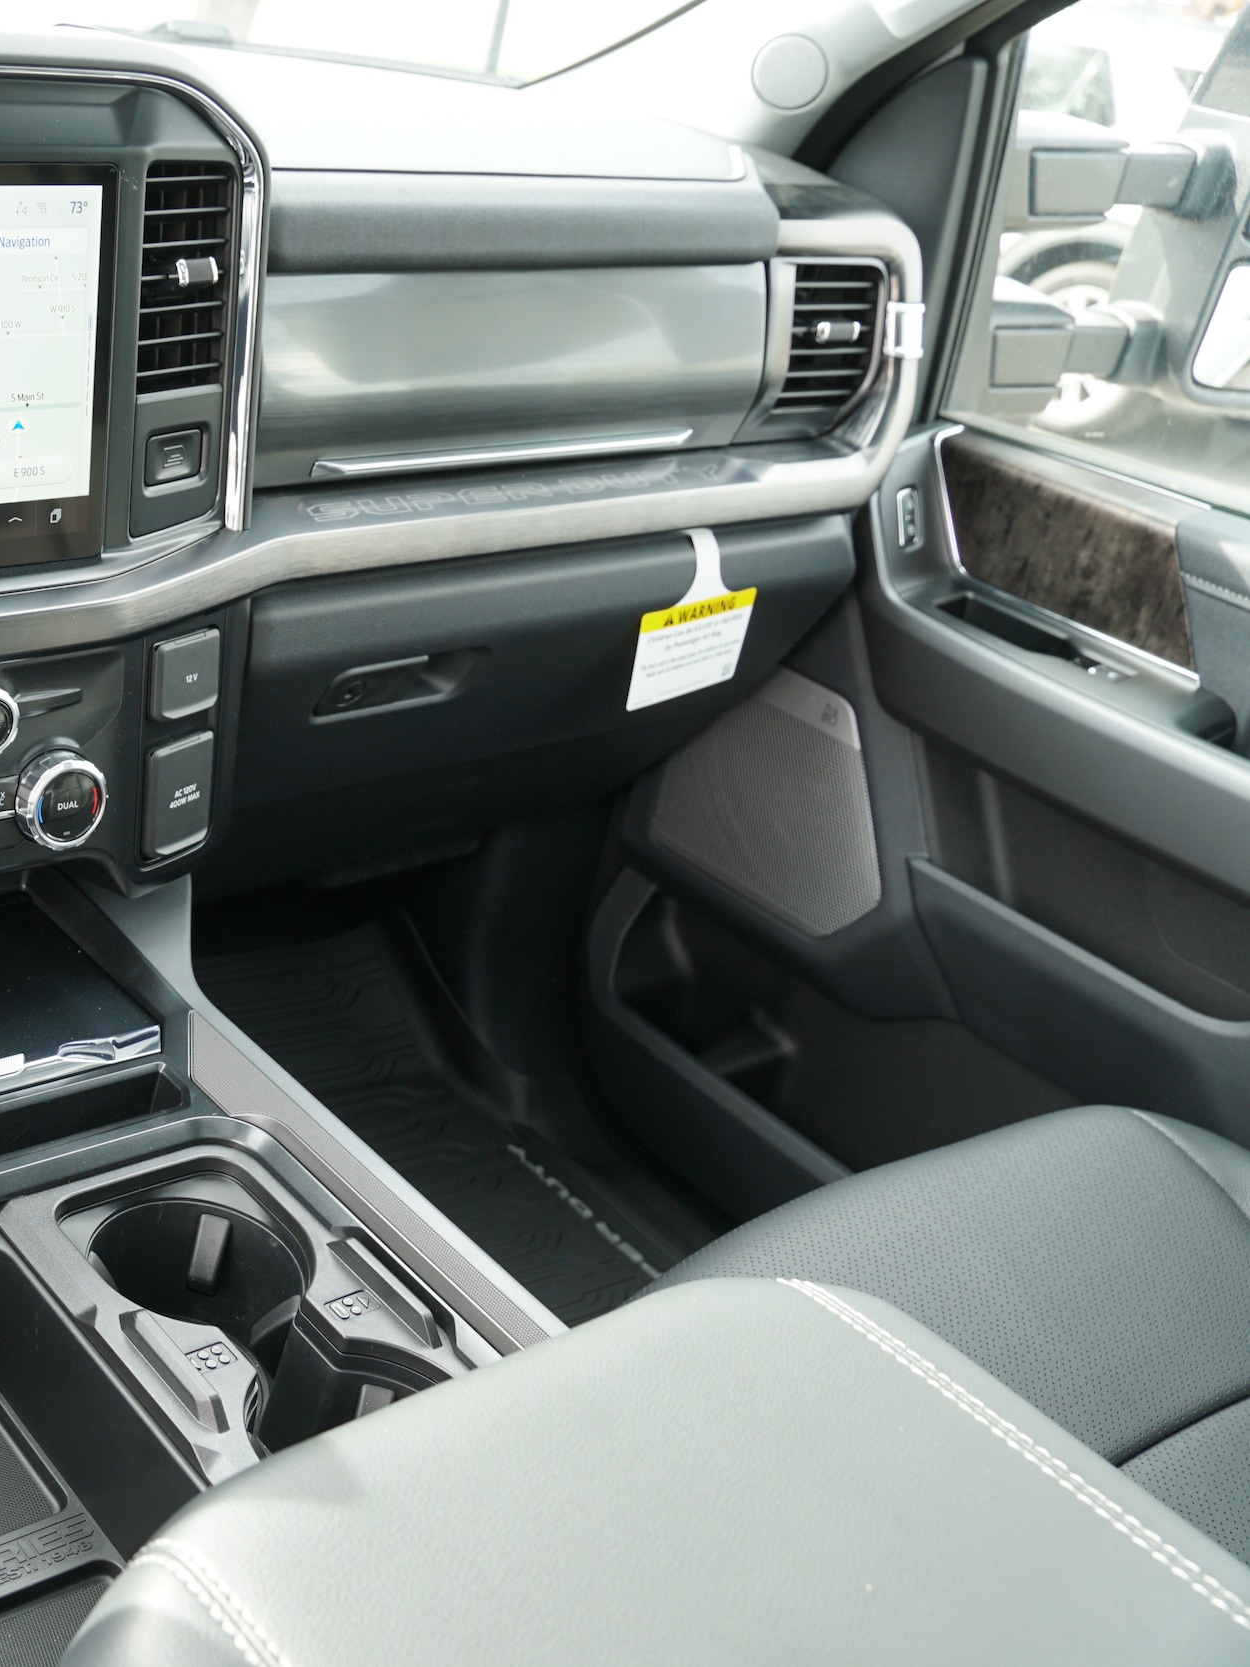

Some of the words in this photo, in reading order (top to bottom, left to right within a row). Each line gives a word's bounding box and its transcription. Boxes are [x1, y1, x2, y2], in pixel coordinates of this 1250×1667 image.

[70, 200, 88, 214] 73°
[21, 274, 49, 284] Bronson
[58, 304, 70, 313] 910
[1, 320, 13, 329] 100
[11, 394, 16, 403] S
[17, 393, 35, 402] Main
[36, 392, 44, 401] St
[14, 468, 19, 478] E
[20, 466, 38, 477] 900
[40, 466, 45, 476] S
[306, 481, 554, 523] SUPER
[677, 596, 737, 624] WARNING
[186, 674, 193, 684] 12
[174, 788, 183, 799] AC
[184, 782, 197, 795] 120V
[57, 800, 79, 811] DUAL
[169, 796, 187, 809] 400W
[187, 790, 200, 804] MAX
[43, 1539, 95, 1566] 1948
